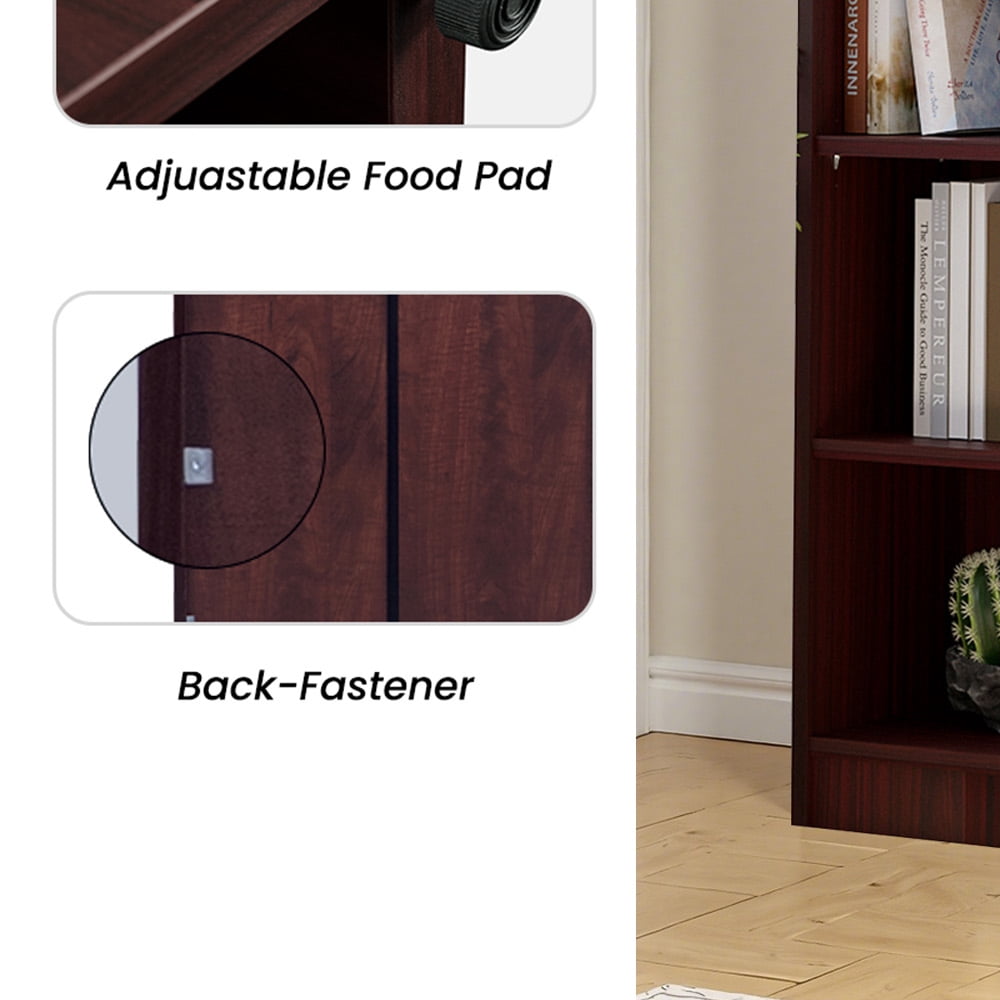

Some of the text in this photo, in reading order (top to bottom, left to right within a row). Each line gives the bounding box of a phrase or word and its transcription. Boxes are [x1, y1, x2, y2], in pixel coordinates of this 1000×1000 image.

[919, 221, 928, 416] The Monocle Guide to Good Business
